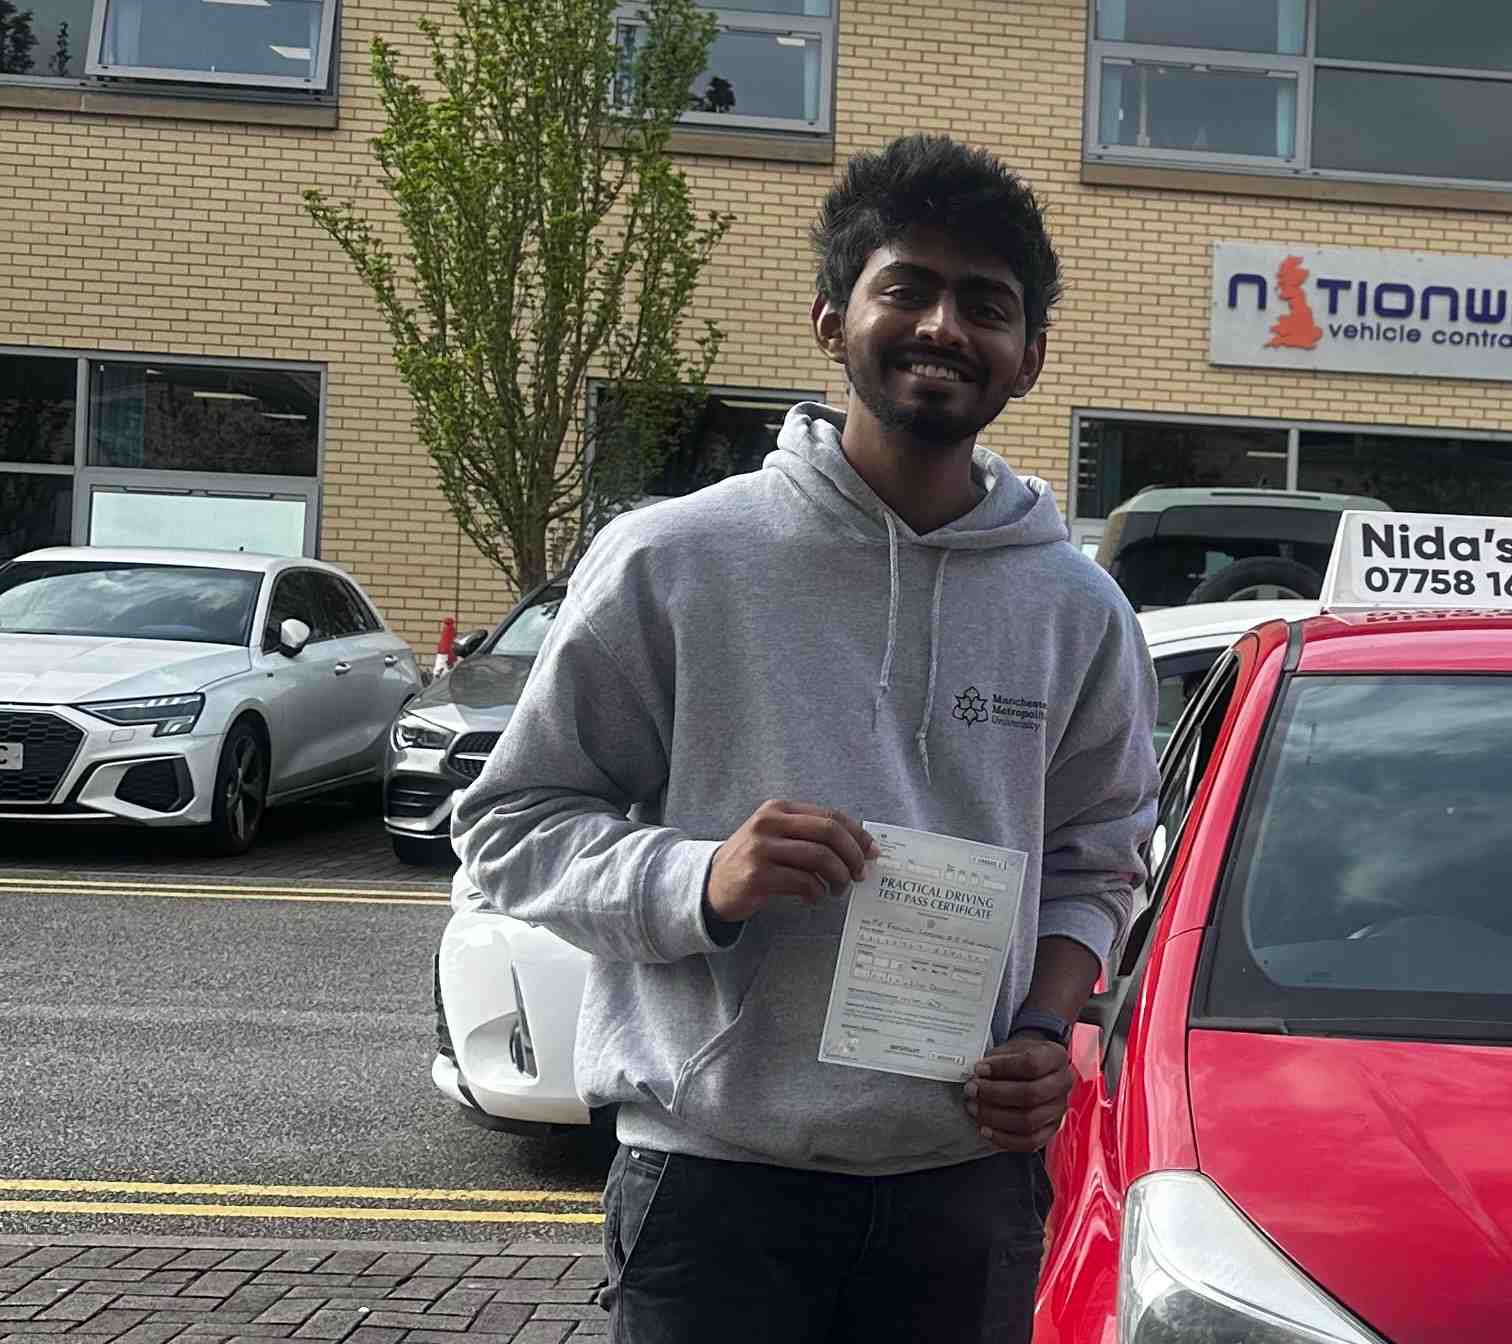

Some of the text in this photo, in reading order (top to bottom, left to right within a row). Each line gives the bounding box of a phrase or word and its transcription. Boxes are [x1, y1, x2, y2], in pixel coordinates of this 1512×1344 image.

[1327, 321, 1422, 344] vehicle
[1364, 565, 1476, 597] 07758
[879, 888, 902, 902] TEST
[903, 893, 929, 906] PASS
[930, 898, 993, 919] CERTIFICATE
[880, 876, 994, 909] PRACTICAL DRIVING
